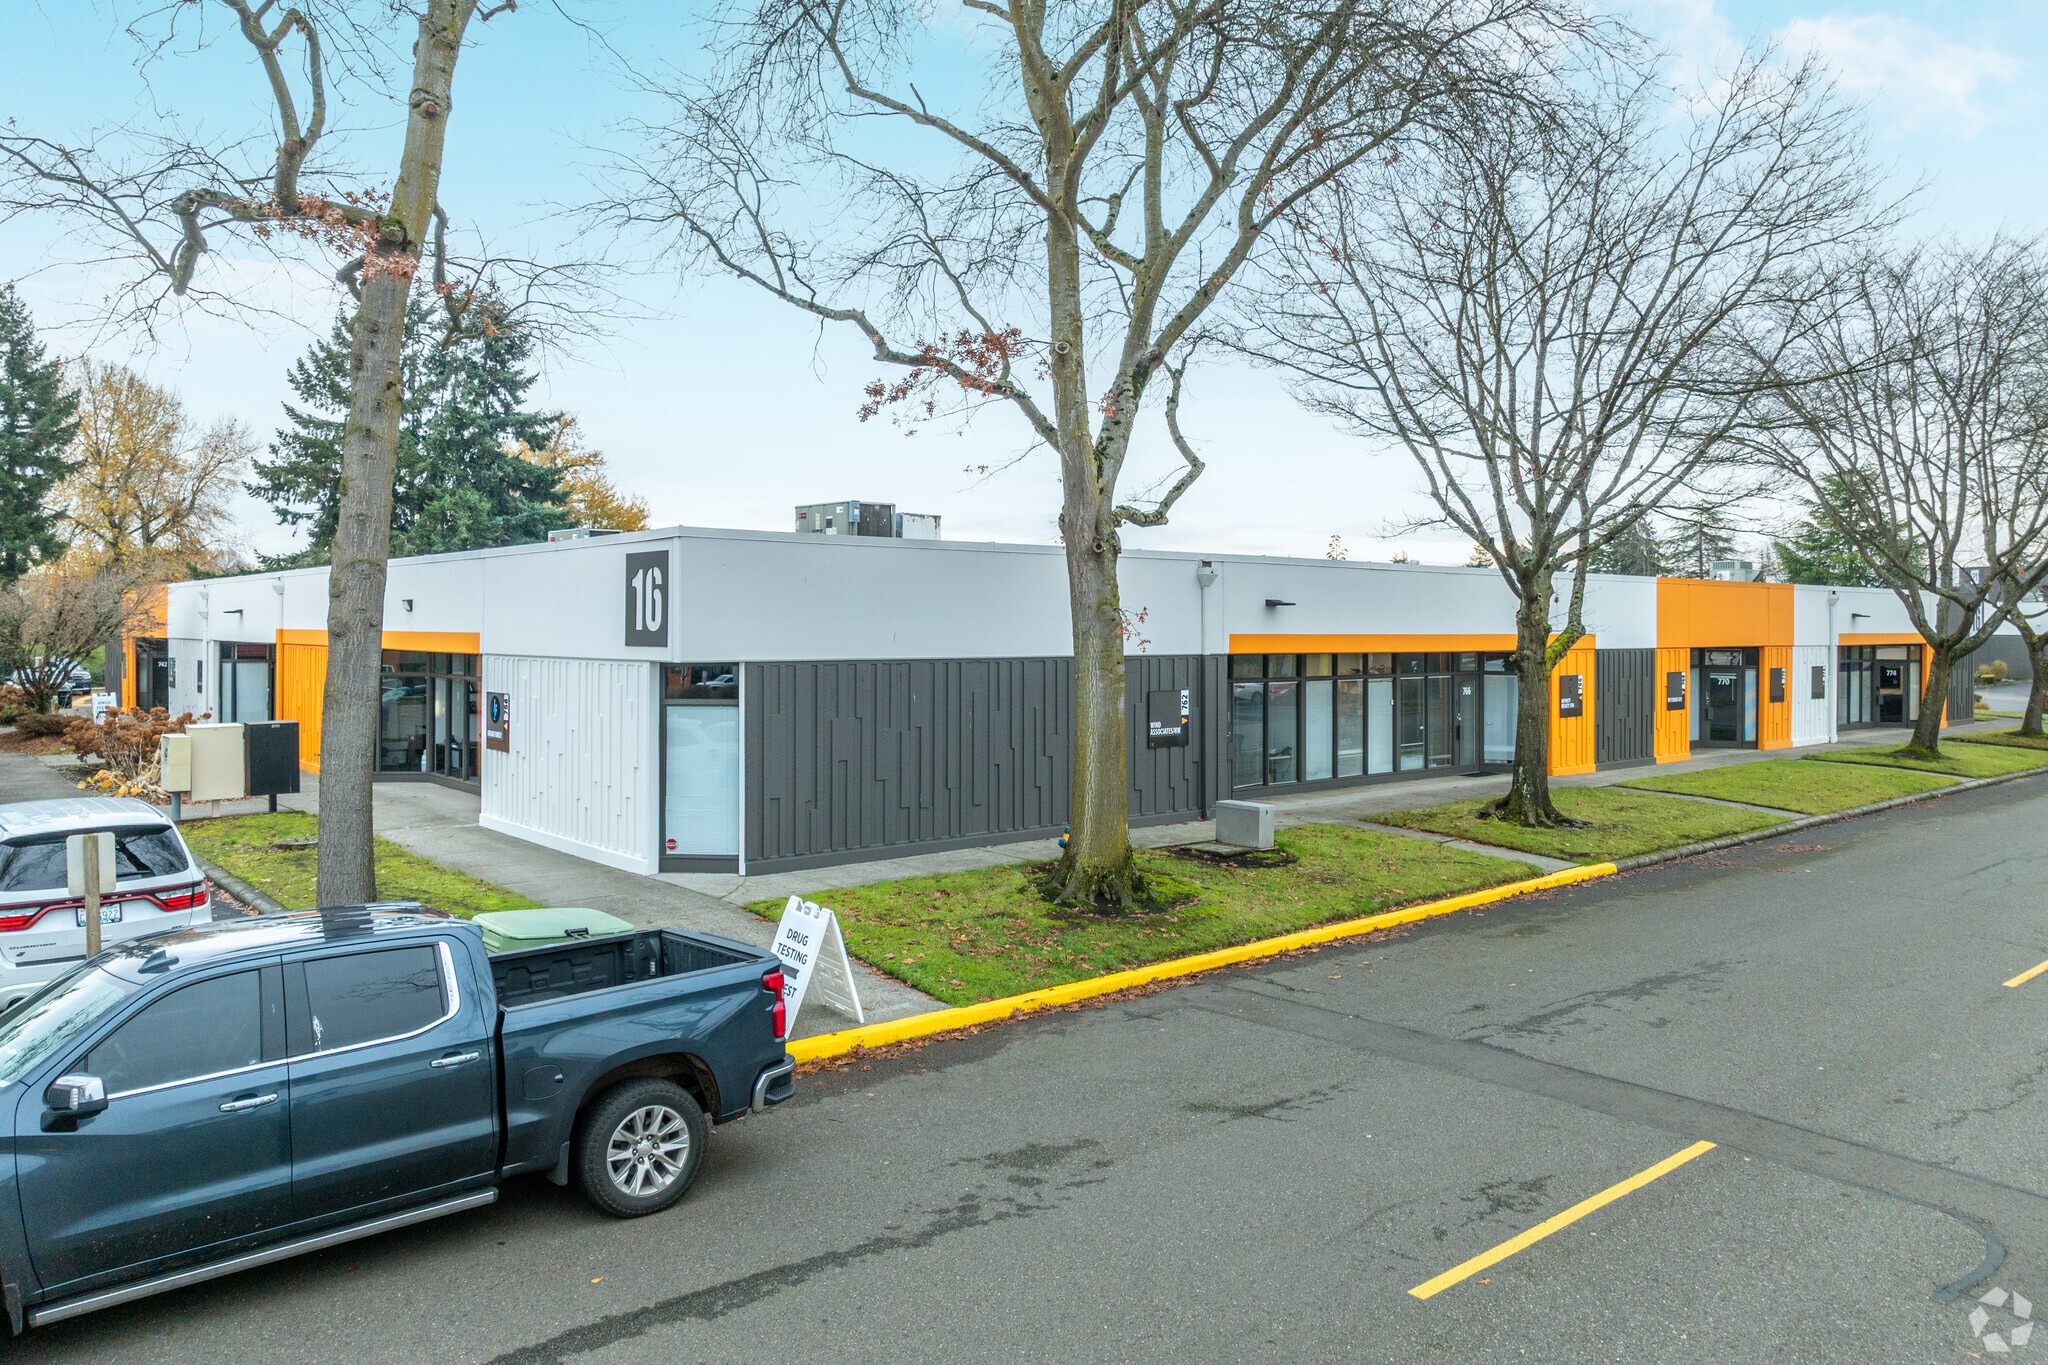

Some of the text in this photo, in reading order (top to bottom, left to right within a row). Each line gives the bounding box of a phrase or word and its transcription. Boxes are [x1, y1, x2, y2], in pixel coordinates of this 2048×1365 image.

[631, 566, 662, 632] 16
[786, 928, 809, 946] DRUG
[777, 942, 808, 965] TESTING
